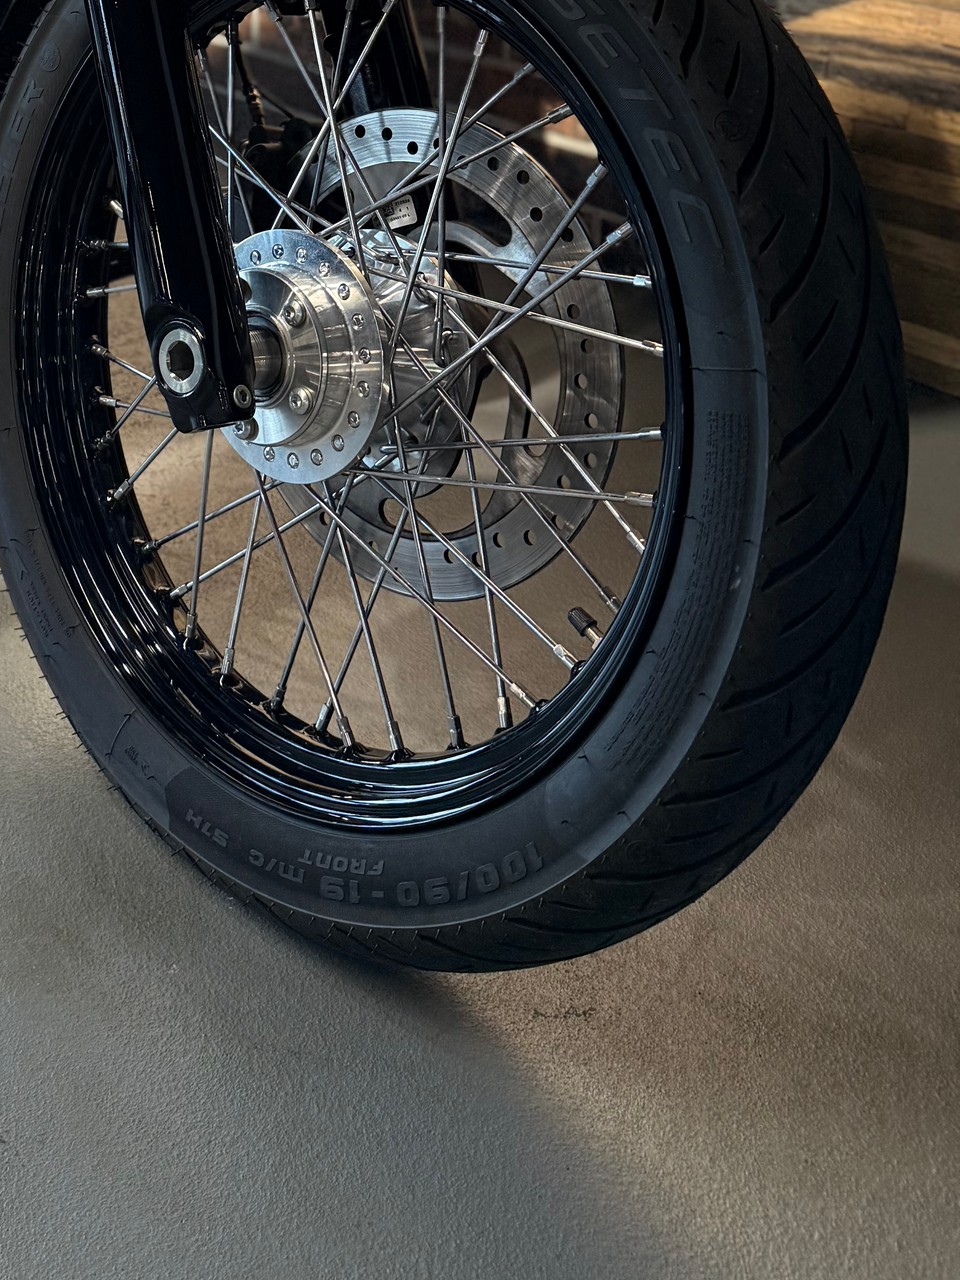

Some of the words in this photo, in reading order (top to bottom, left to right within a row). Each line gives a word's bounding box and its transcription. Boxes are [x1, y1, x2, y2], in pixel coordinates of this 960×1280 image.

[297, 848, 385, 876] FRONT
[396, 840, 543, 908] 100/90
[319, 875, 360, 904] 19
